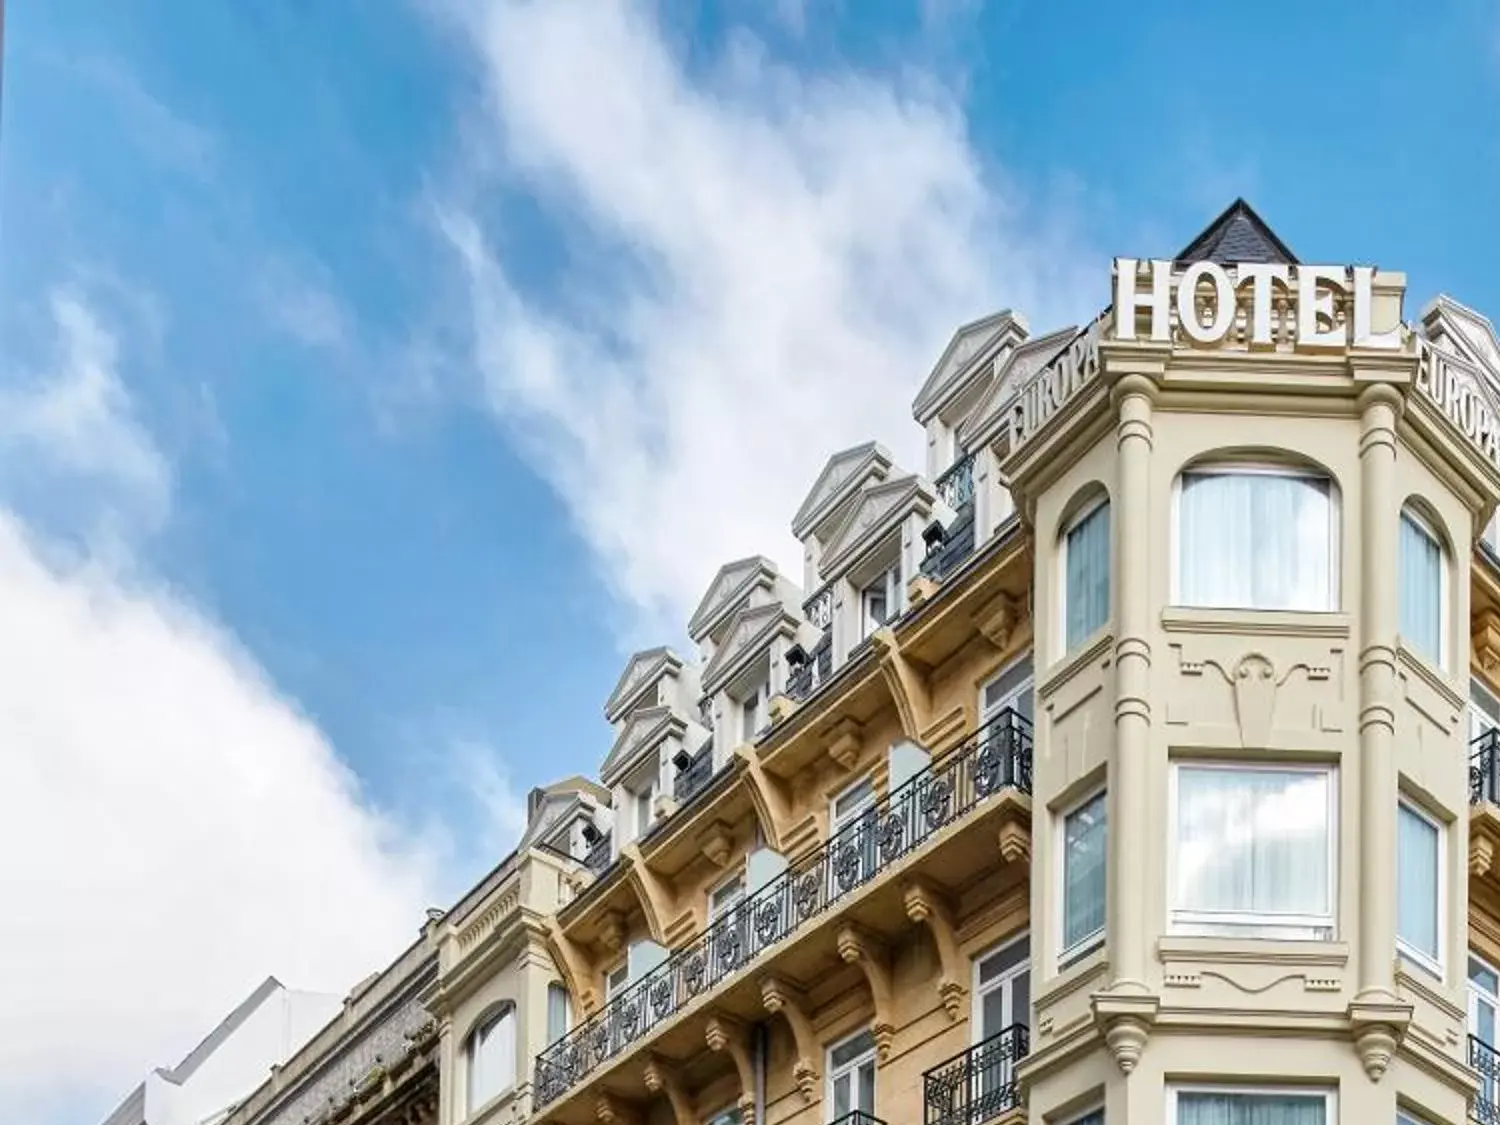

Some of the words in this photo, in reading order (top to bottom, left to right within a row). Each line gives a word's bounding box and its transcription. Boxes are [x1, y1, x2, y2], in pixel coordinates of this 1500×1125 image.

[1115, 257, 1402, 348] HOTEL
[1009, 333, 1099, 450] EUROPA
[1416, 338, 1500, 467] EUROPA
